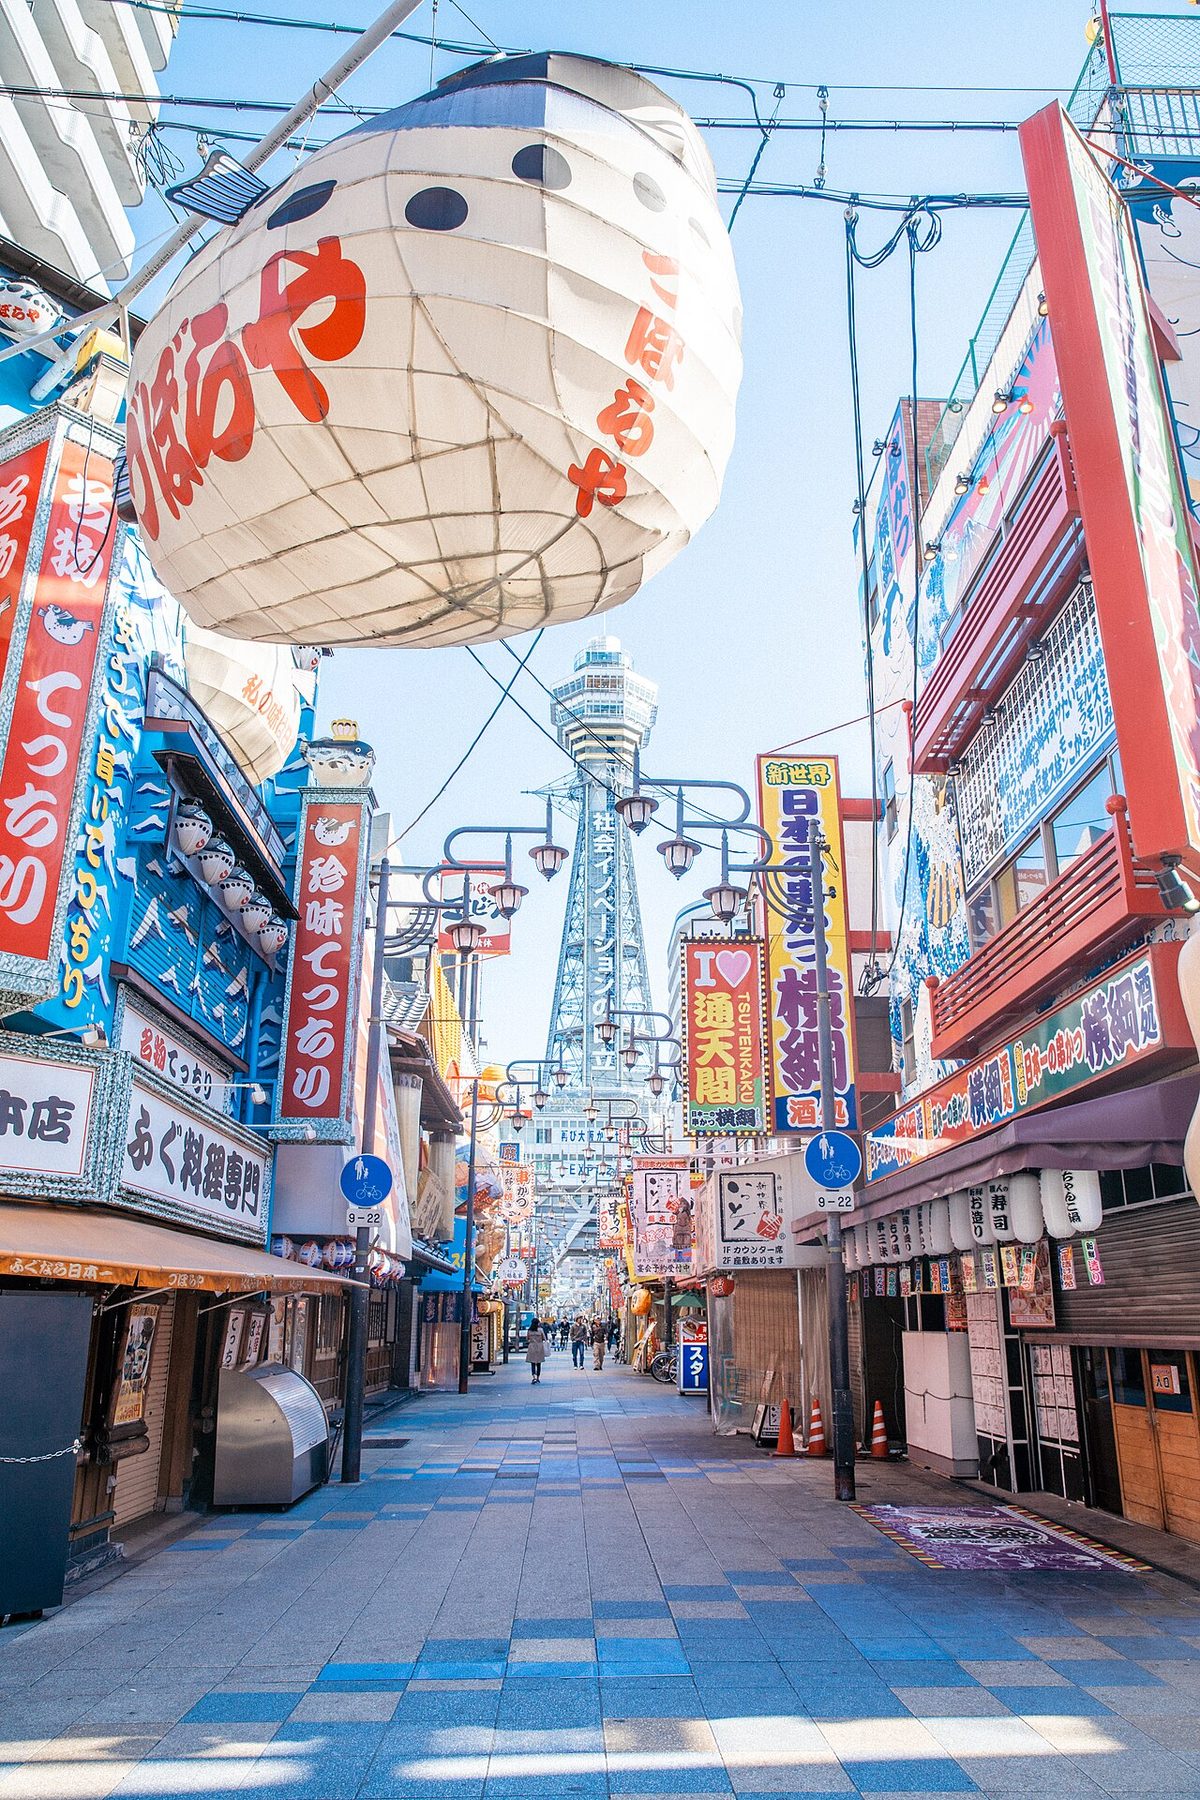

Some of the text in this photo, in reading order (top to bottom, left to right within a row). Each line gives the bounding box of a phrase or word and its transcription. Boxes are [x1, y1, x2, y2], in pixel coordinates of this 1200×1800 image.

[0, 671, 82, 925] てっちり
[766, 762, 830, 785] 新世界
[292, 854, 347, 1108] 珍味てっちり
[693, 991, 737, 1105] 通天閣
[737, 992, 755, 1104] TSUTENKAKU
[776, 968, 848, 1092] 横綱
[1023, 1029, 1084, 1090] 日本一の串かつ
[1082, 975, 1140, 1070] 横綱
[1134, 964, 1159, 1045] 酒処
[968, 1057, 1003, 1128] 横綱
[999, 1051, 1013, 1112] 酒処
[127, 1104, 260, 1217] ふぐ料理専門
[516, 1170, 529, 1207] 串かつ
[991, 1194, 1009, 1231] 寿司
[970, 1197, 984, 1238] お造り
[10, 1257, 113, 1280] ふぐなら日本一
[722, 1246, 784, 1254] 1F カウンター席
[722, 1256, 784, 1265] 2F 座敷あります
[224, 1317, 239, 1367] てっち
[689, 1346, 704, 1387] スター
